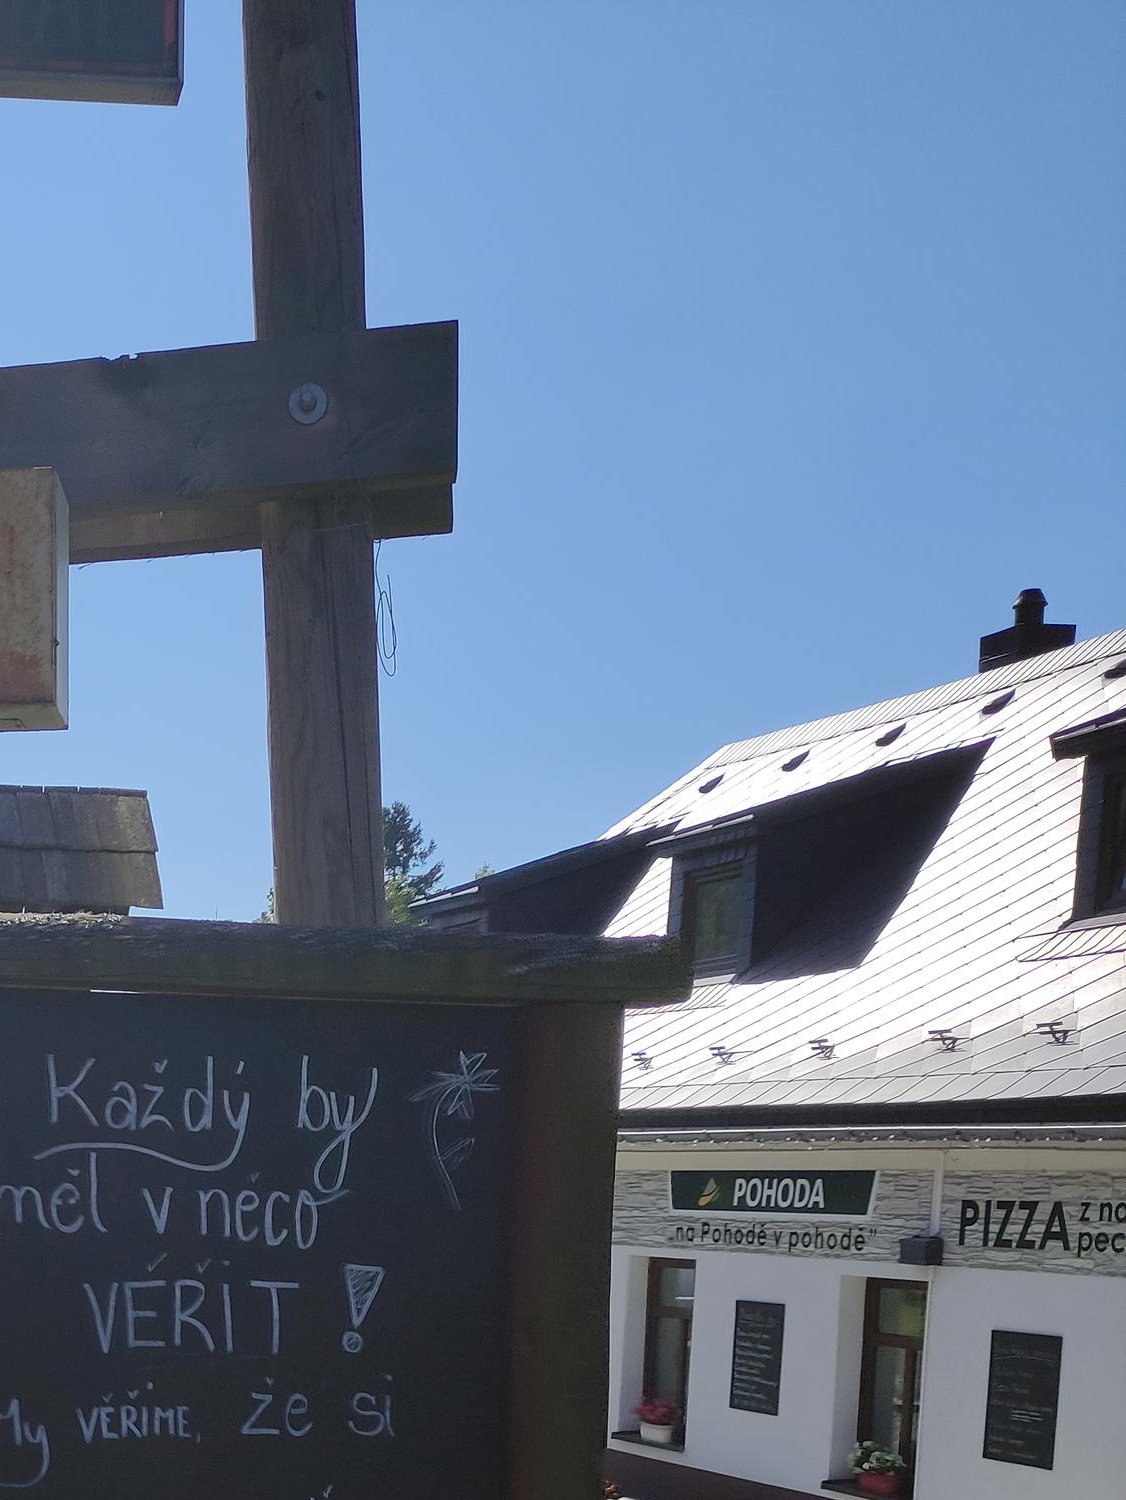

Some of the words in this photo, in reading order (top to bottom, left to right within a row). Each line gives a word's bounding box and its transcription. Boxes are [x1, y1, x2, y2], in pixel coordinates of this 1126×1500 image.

[34, 1054, 250, 1171] Každý
[297, 1056, 378, 1192] by
[142, 1186, 173, 1234] v
[198, 1172, 349, 1249] něco
[733, 1178, 825, 1209] POHODA
[700, 1222, 767, 1246] Pohodě
[959, 1200, 1071, 1250] PIZZA
[1077, 1232, 1126, 1258] pec
